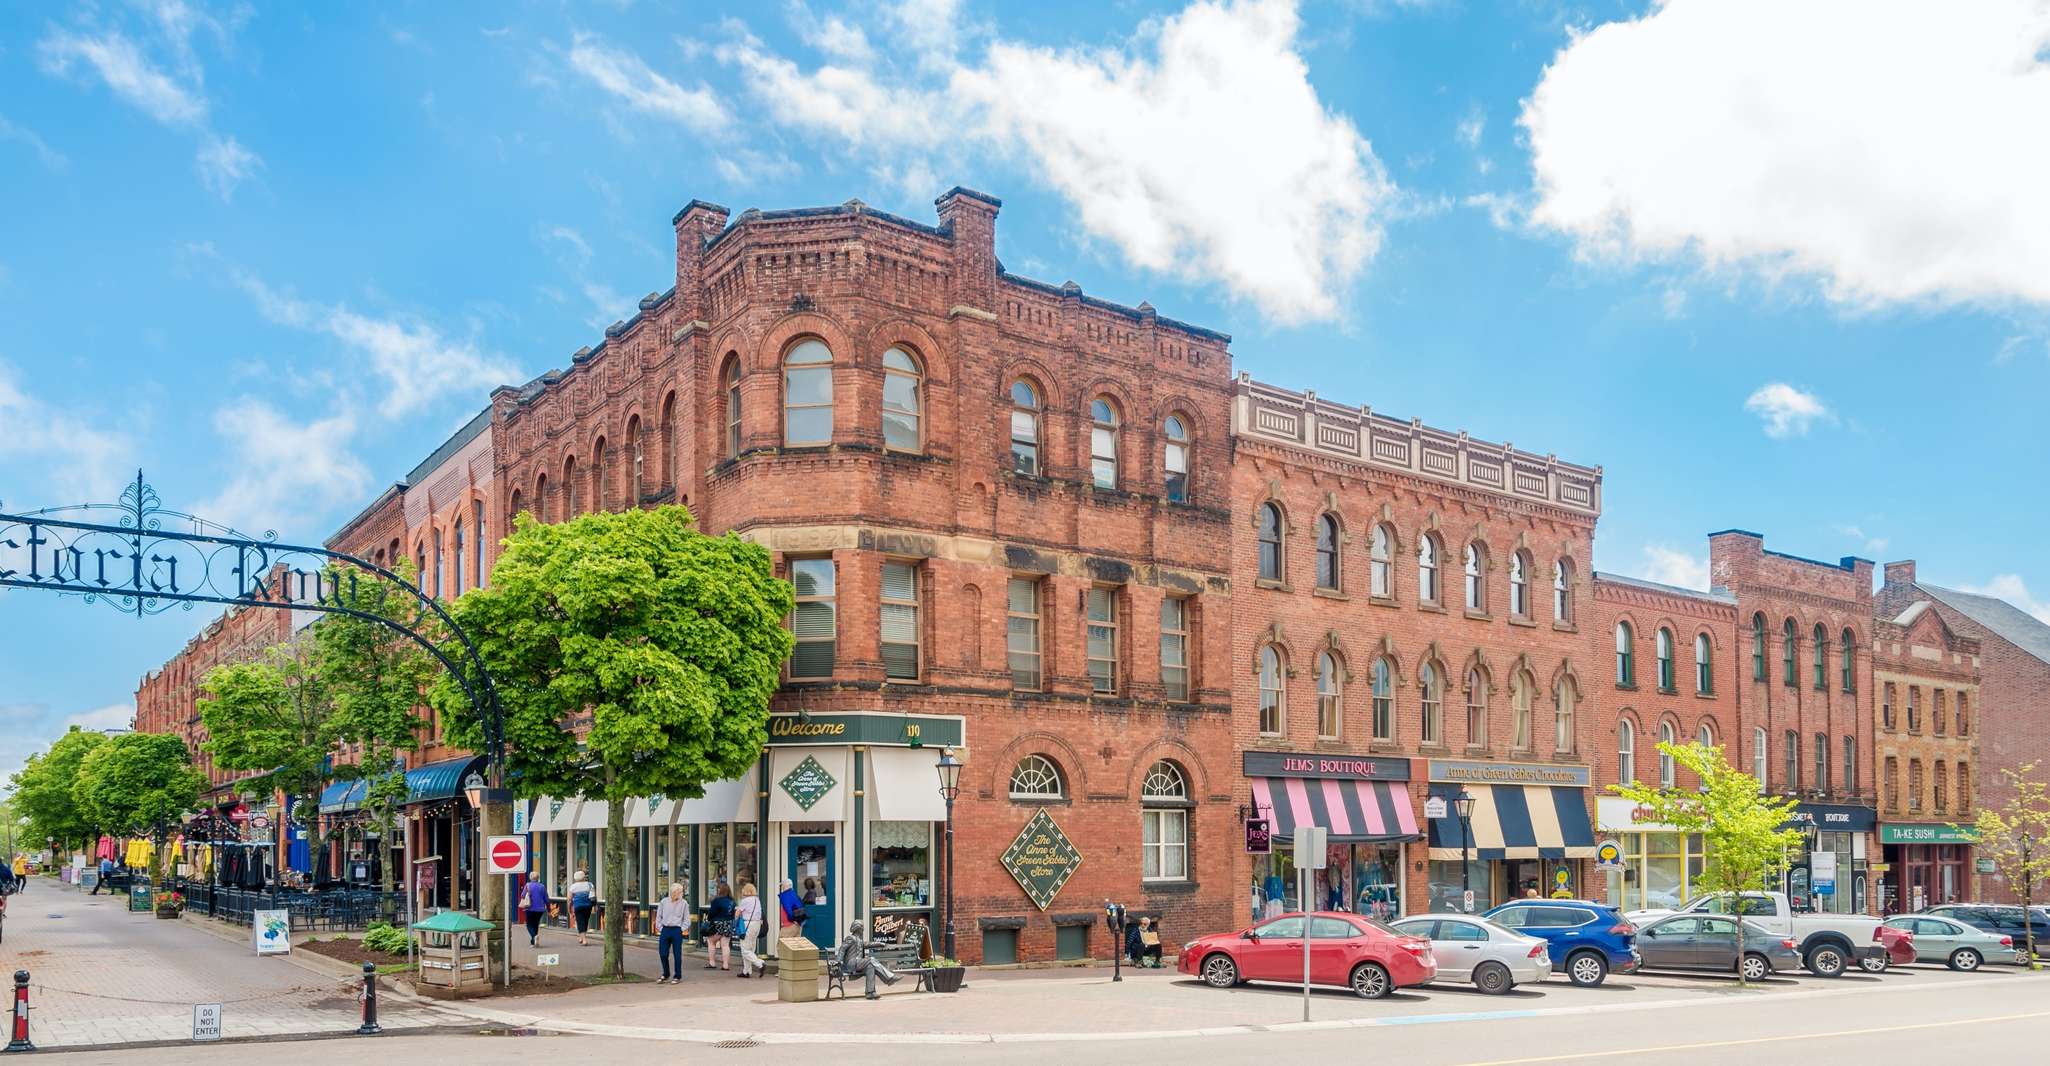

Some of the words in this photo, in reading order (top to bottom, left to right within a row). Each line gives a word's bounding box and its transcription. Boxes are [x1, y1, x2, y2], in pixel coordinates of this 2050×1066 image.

[772, 717, 846, 737] Welcome
[906, 723, 920, 738] 110
[1283, 758, 1315, 772] JEMS
[1320, 760, 1377, 777] BOUTIQUE
[1034, 834, 1051, 846] The
[1892, 828, 1913, 839] TA-KE
[1914, 828, 1936, 840] SUSHI
[874, 914, 894, 927] Anne
[880, 917, 904, 934] Gilbert
[203, 1008, 213, 1017] DO
[200, 1018, 215, 1026] NOT
[195, 1027, 219, 1036] ENTER
